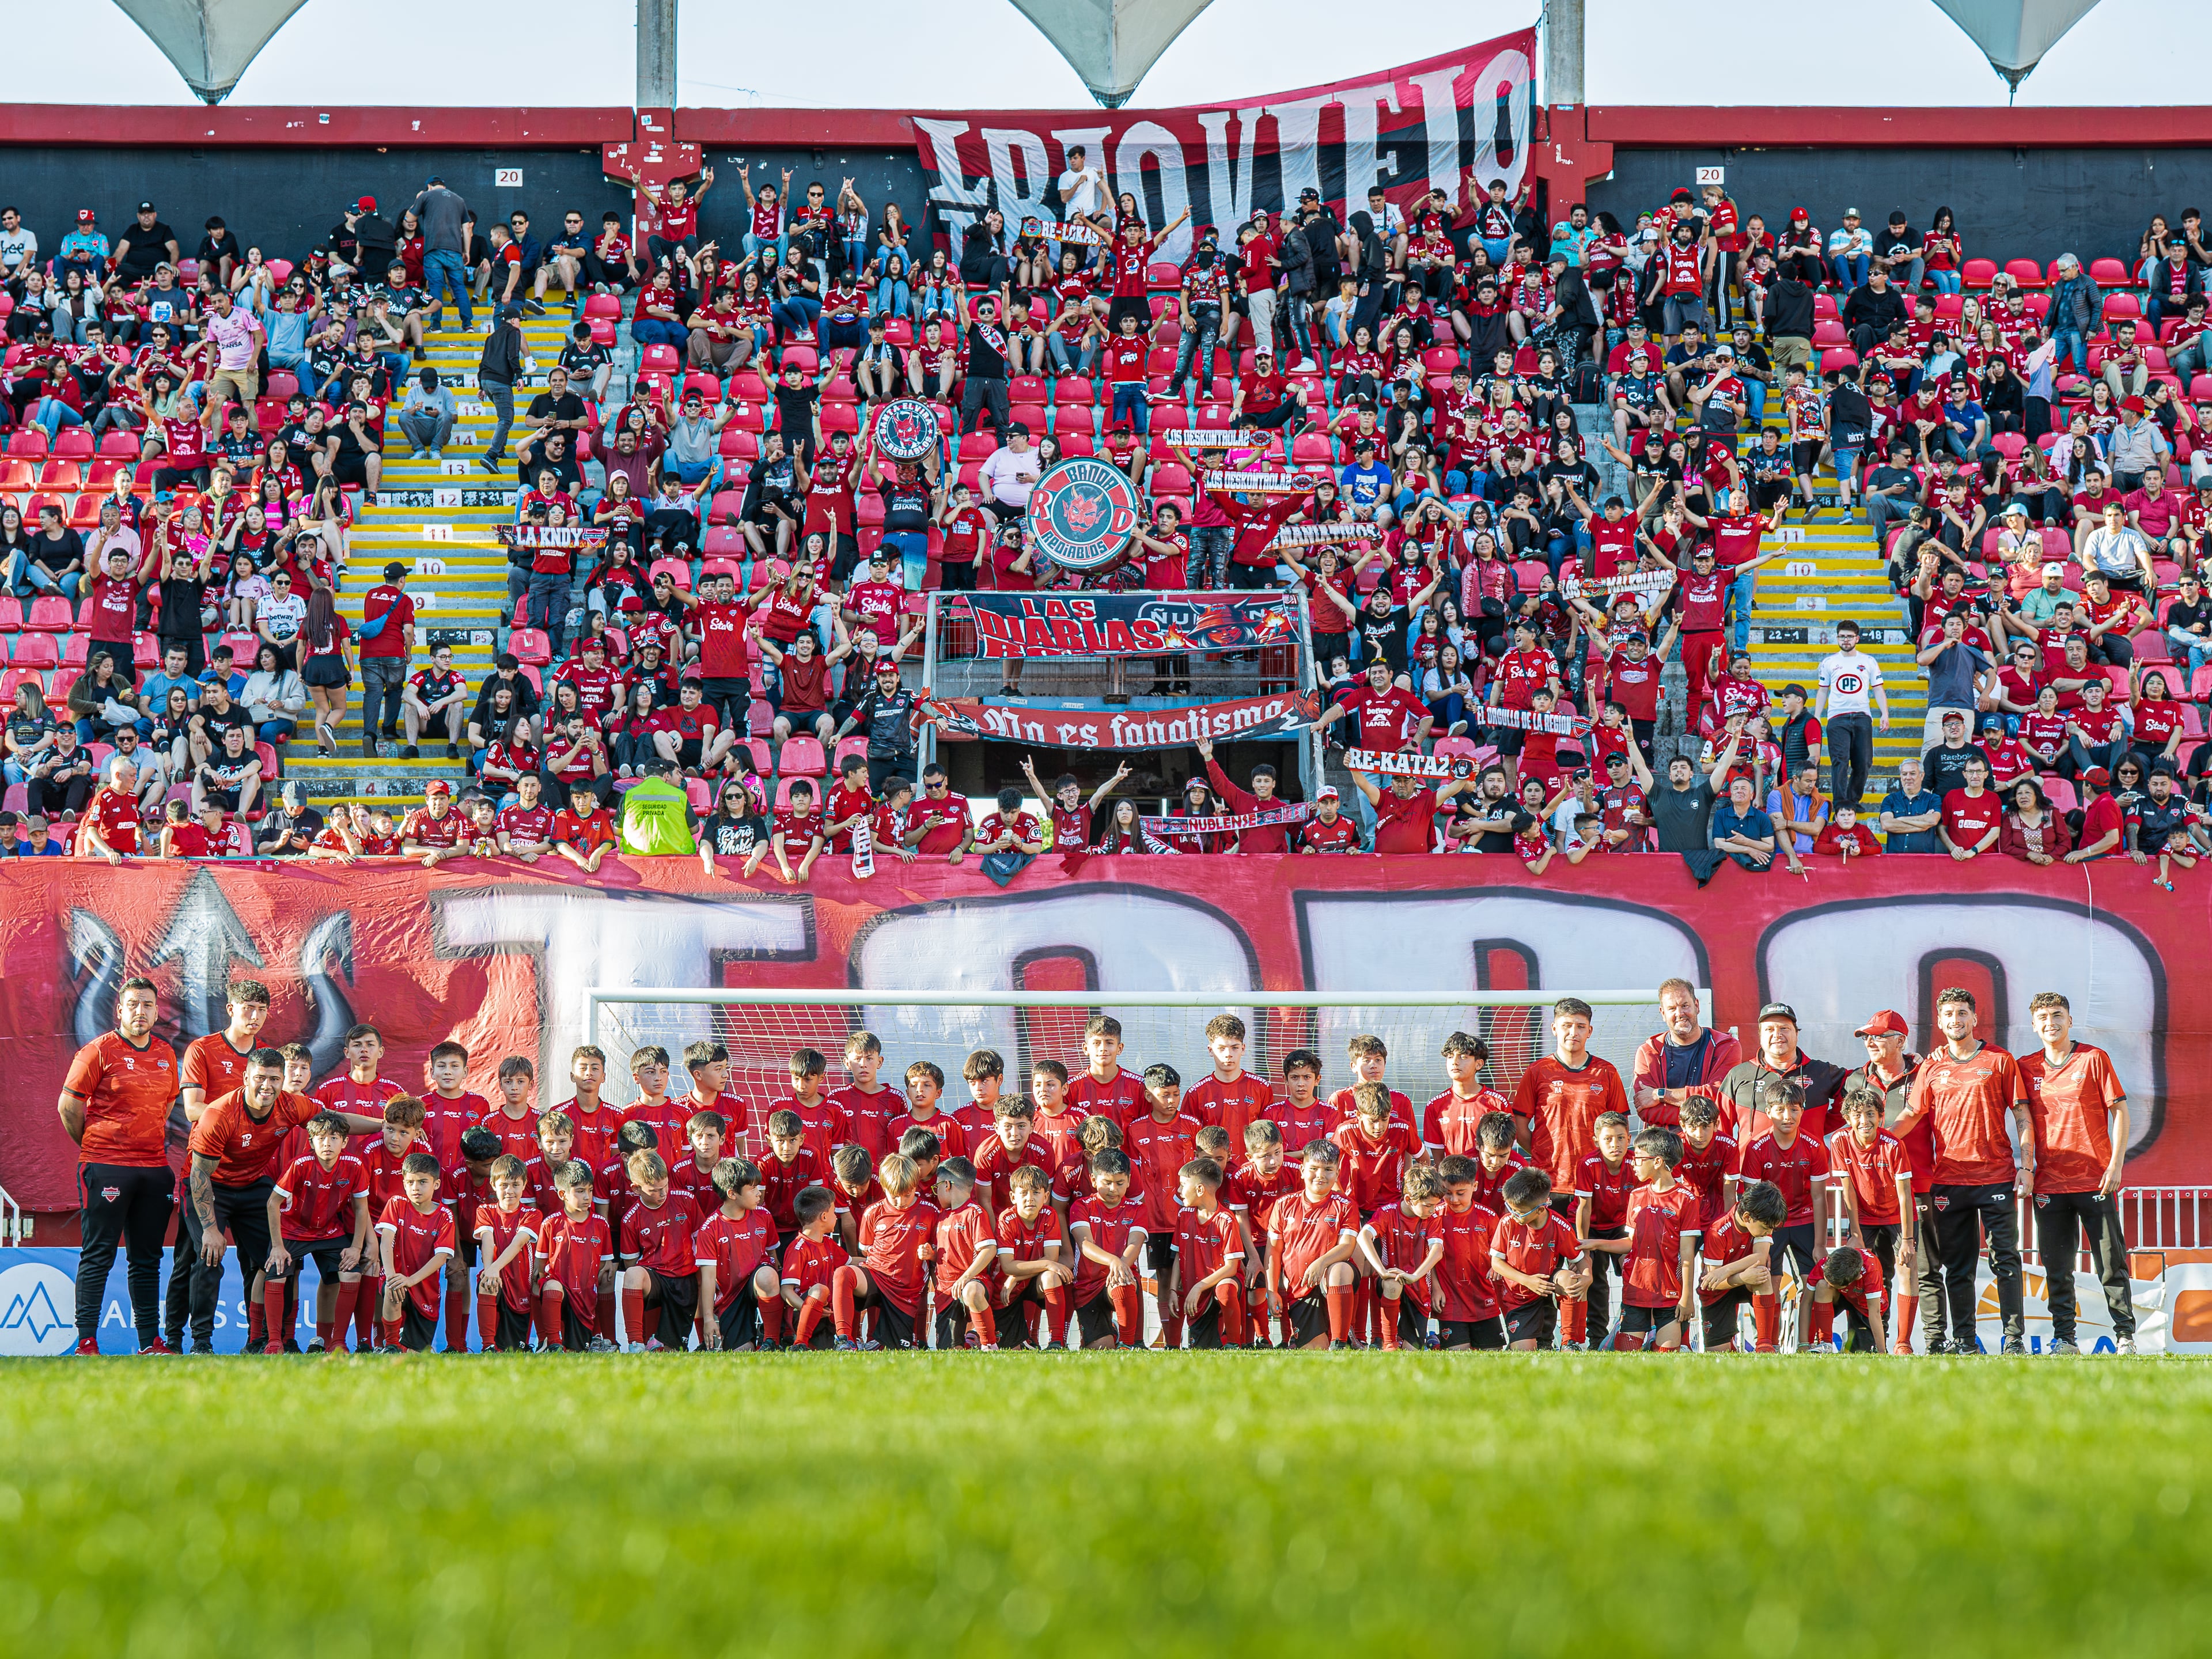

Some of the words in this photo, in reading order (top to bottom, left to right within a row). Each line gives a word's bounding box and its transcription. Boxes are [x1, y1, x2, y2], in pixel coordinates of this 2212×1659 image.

[501, 172, 518, 181] 20
[1702, 170, 1719, 180] 20
[1041, 221, 1100, 244] RE-LOKAS
[1, 241, 24, 253] Lee
[465, 406, 481, 416] 15
[880, 405, 901, 434] SANTA
[903, 402, 933, 431] ELVIRA
[454, 436, 472, 446] 14
[1166, 430, 1181, 445] LOS
[886, 435, 933, 457] REDIABLOS
[449, 465, 464, 475] 13
[1067, 464, 1119, 490] BANDA
[441, 495, 457, 506] 12
[1029, 489, 1053, 520] R
[1111, 507, 1136, 533] D
[431, 529, 445, 540] 11
[517, 527, 536, 546] LA
[539, 527, 583, 547] KNDY
[1784, 531, 1798, 541] 11
[422, 563, 440, 574] 10
[1794, 565, 1810, 576] 10
[416, 597, 425, 609] 9
[775, 596, 802, 616] Stake
[861, 597, 892, 615] Stake
[1021, 598, 1096, 619] LAS
[710, 617, 734, 631] Stake
[976, 607, 1165, 652] DIABLAS
[476, 635, 486, 643] P5
[1769, 631, 1782, 639] 22
[581, 685, 605, 694] betway
[1843, 678, 1856, 690] PF
[1367, 707, 1393, 716] betway
[1477, 706, 1486, 725] EL
[1486, 707, 1520, 728] ORGULLO
[1521, 712, 1532, 729] DE
[1533, 713, 1543, 730] LA
[1058, 723, 1099, 747] es
[1109, 699, 1285, 747] fanatismo
[2145, 718, 2171, 732] Stake
[1349, 748, 1450, 777] RE-KATA2
[365, 783, 377, 796] 4
[1188, 813, 1257, 834] ÑUBLENSE
